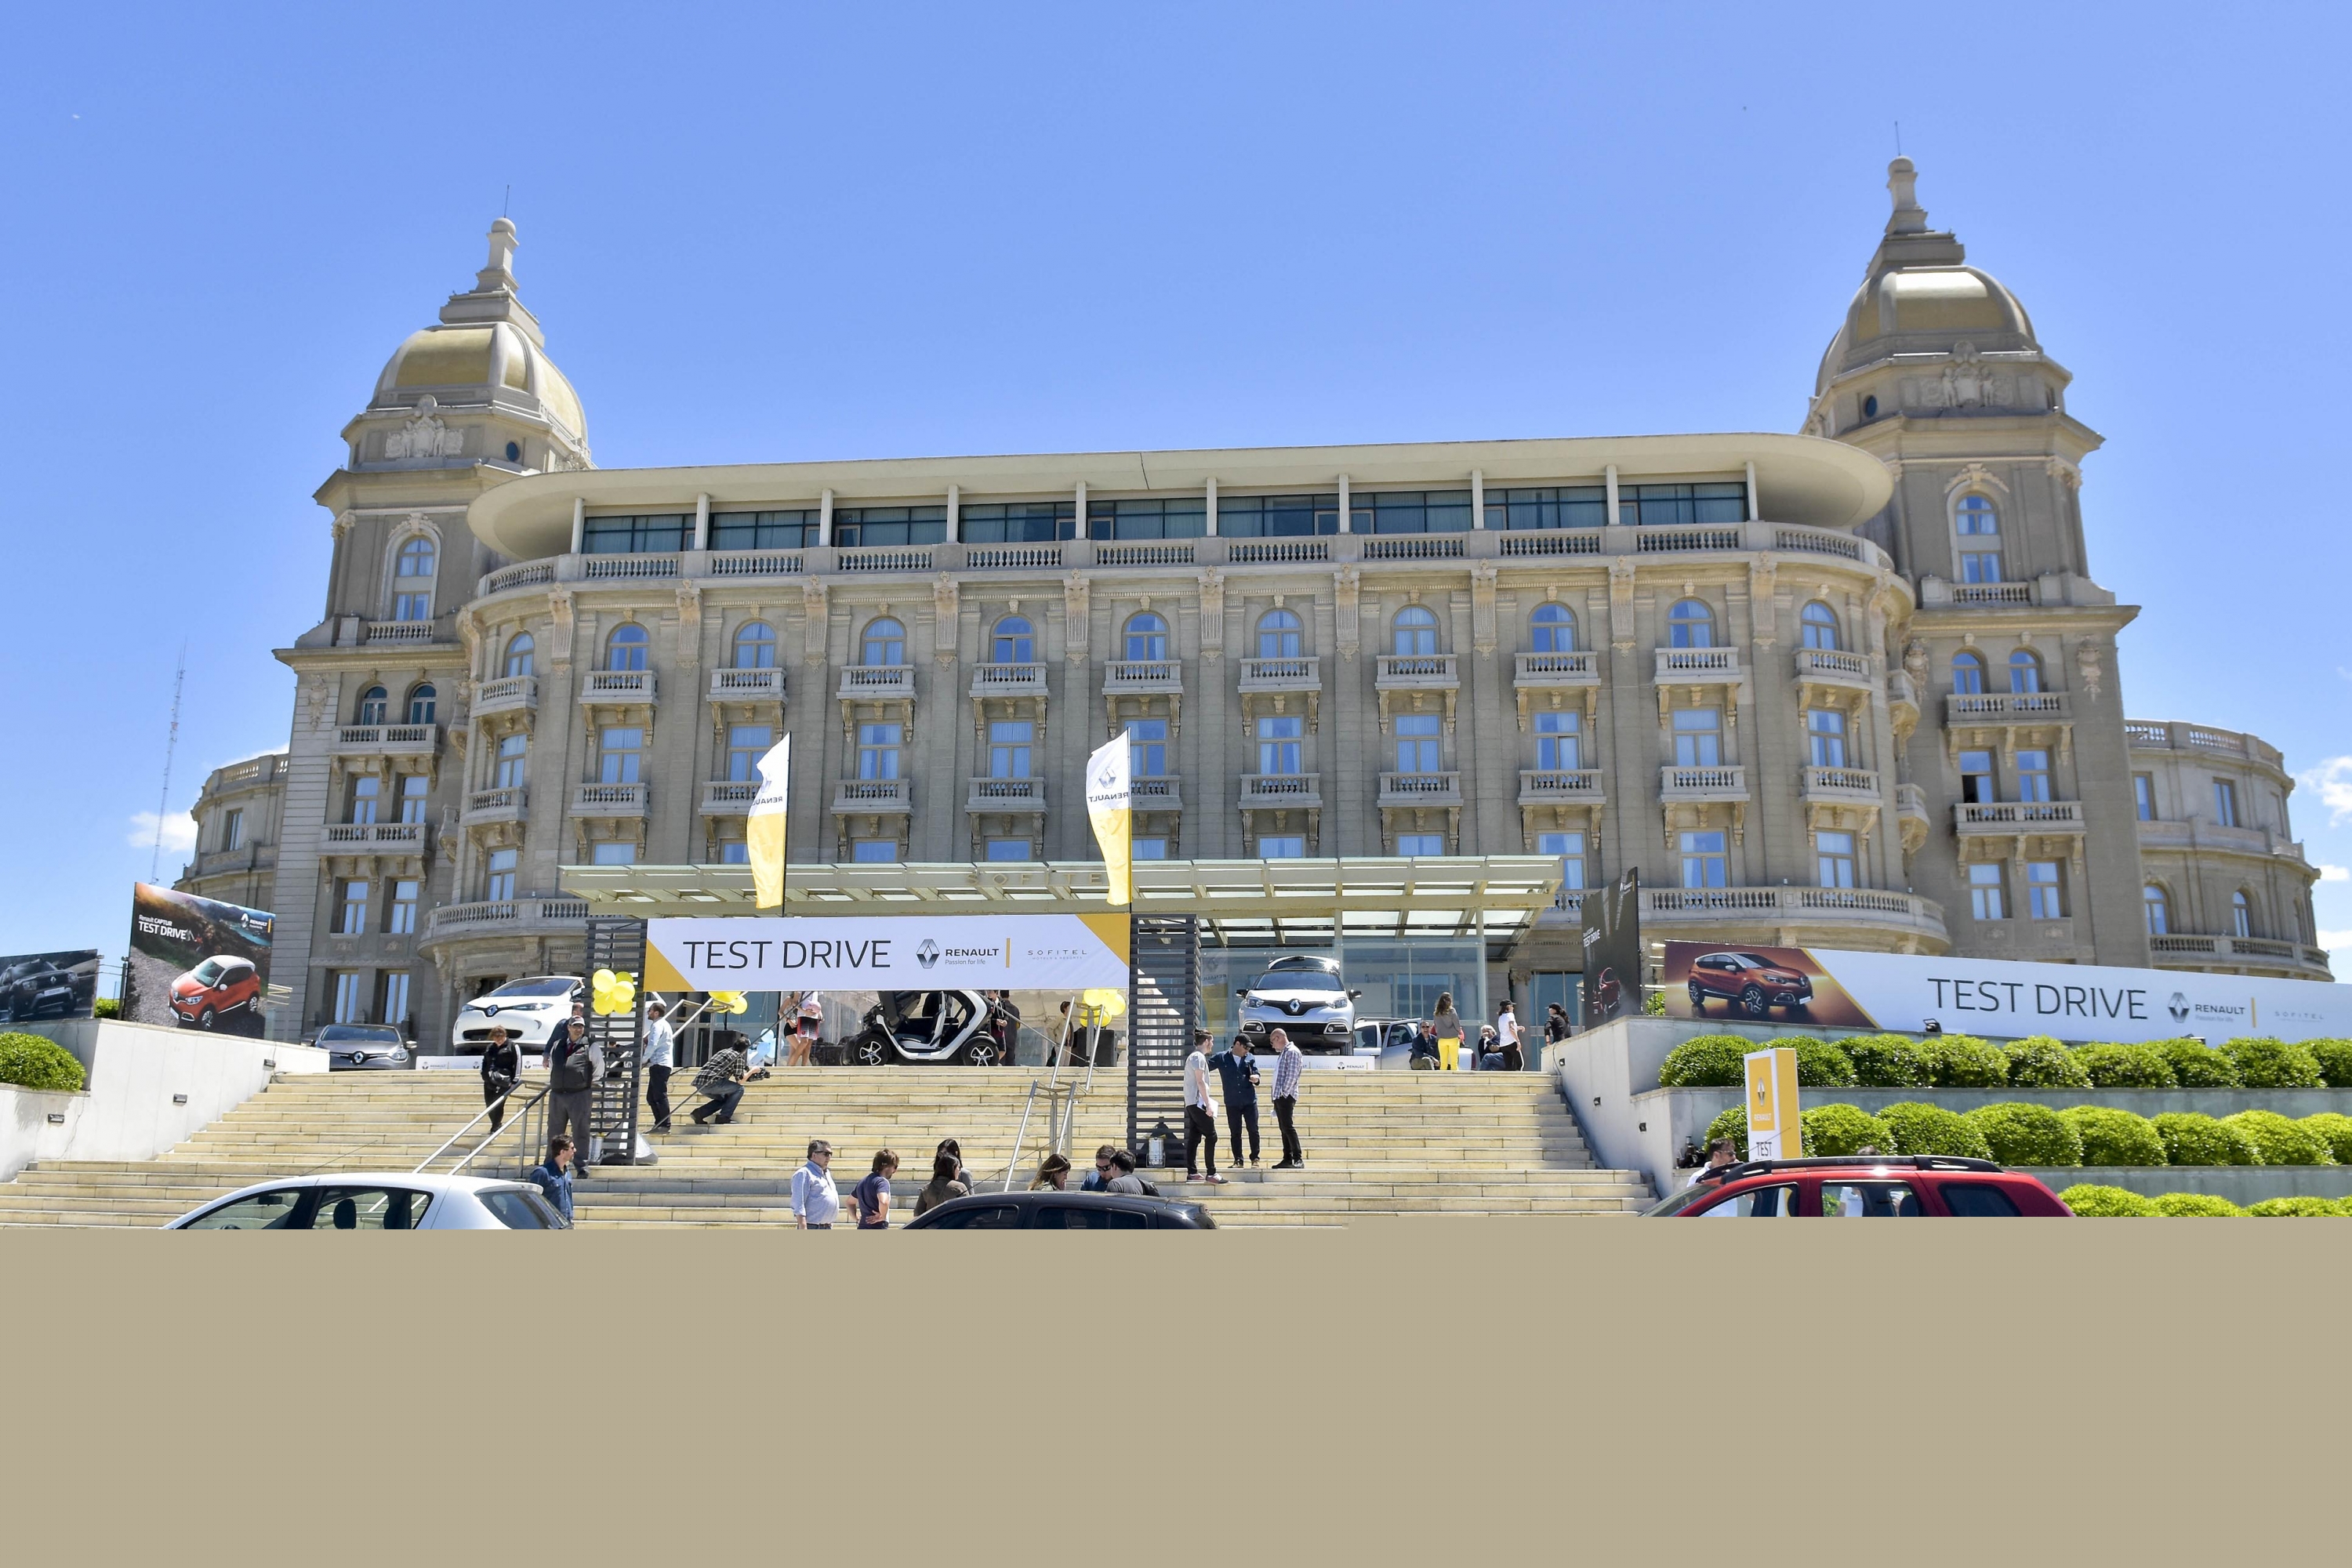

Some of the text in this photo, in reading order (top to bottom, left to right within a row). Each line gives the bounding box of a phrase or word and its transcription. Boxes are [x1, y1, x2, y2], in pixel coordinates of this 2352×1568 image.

[967, 873, 1102, 885] SOFITE
[139, 914, 154, 923] Renault
[139, 921, 187, 939] TEST DRIVE
[683, 940, 891, 968] TEST DRIVE
[1927, 978, 2147, 1019] TEST DRIVE
[2195, 1004, 2245, 1014] RENAULT
[2274, 1011, 2325, 1020] SOFITEL
[1756, 1142, 1772, 1156] TEST
